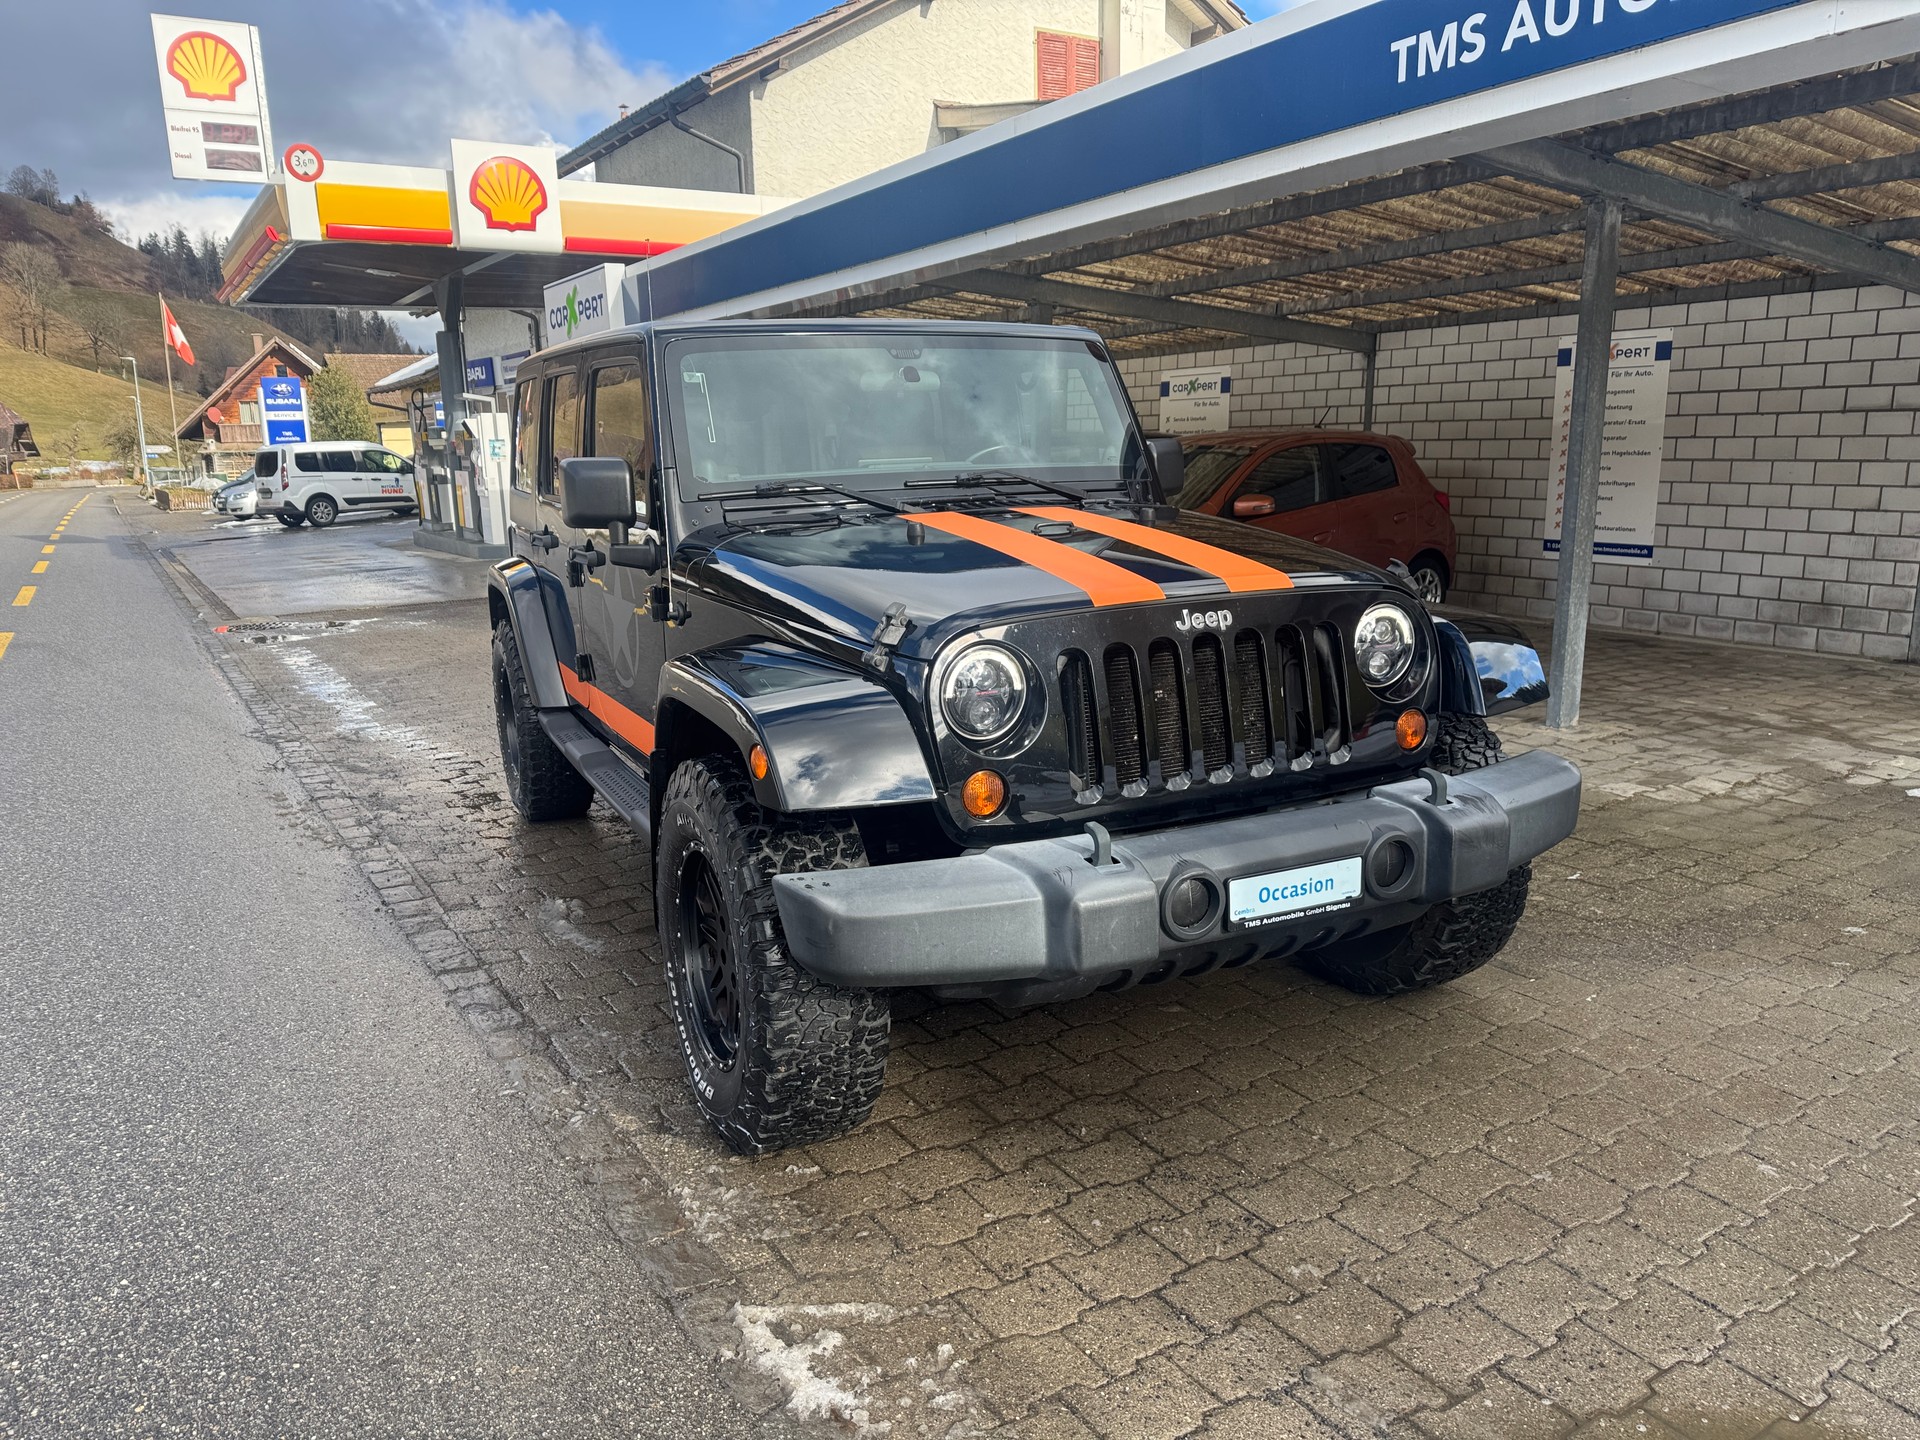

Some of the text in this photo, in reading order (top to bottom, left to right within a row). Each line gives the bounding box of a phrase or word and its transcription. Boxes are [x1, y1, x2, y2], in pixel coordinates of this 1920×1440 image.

[1390, 12, 1488, 84] TMS
[1175, 608, 1233, 631] Jeep
[1258, 877, 1335, 904] Occasion
[1234, 907, 1256, 916] Cembra
[1244, 902, 1351, 929] TMS Automobile GmbH Signau
